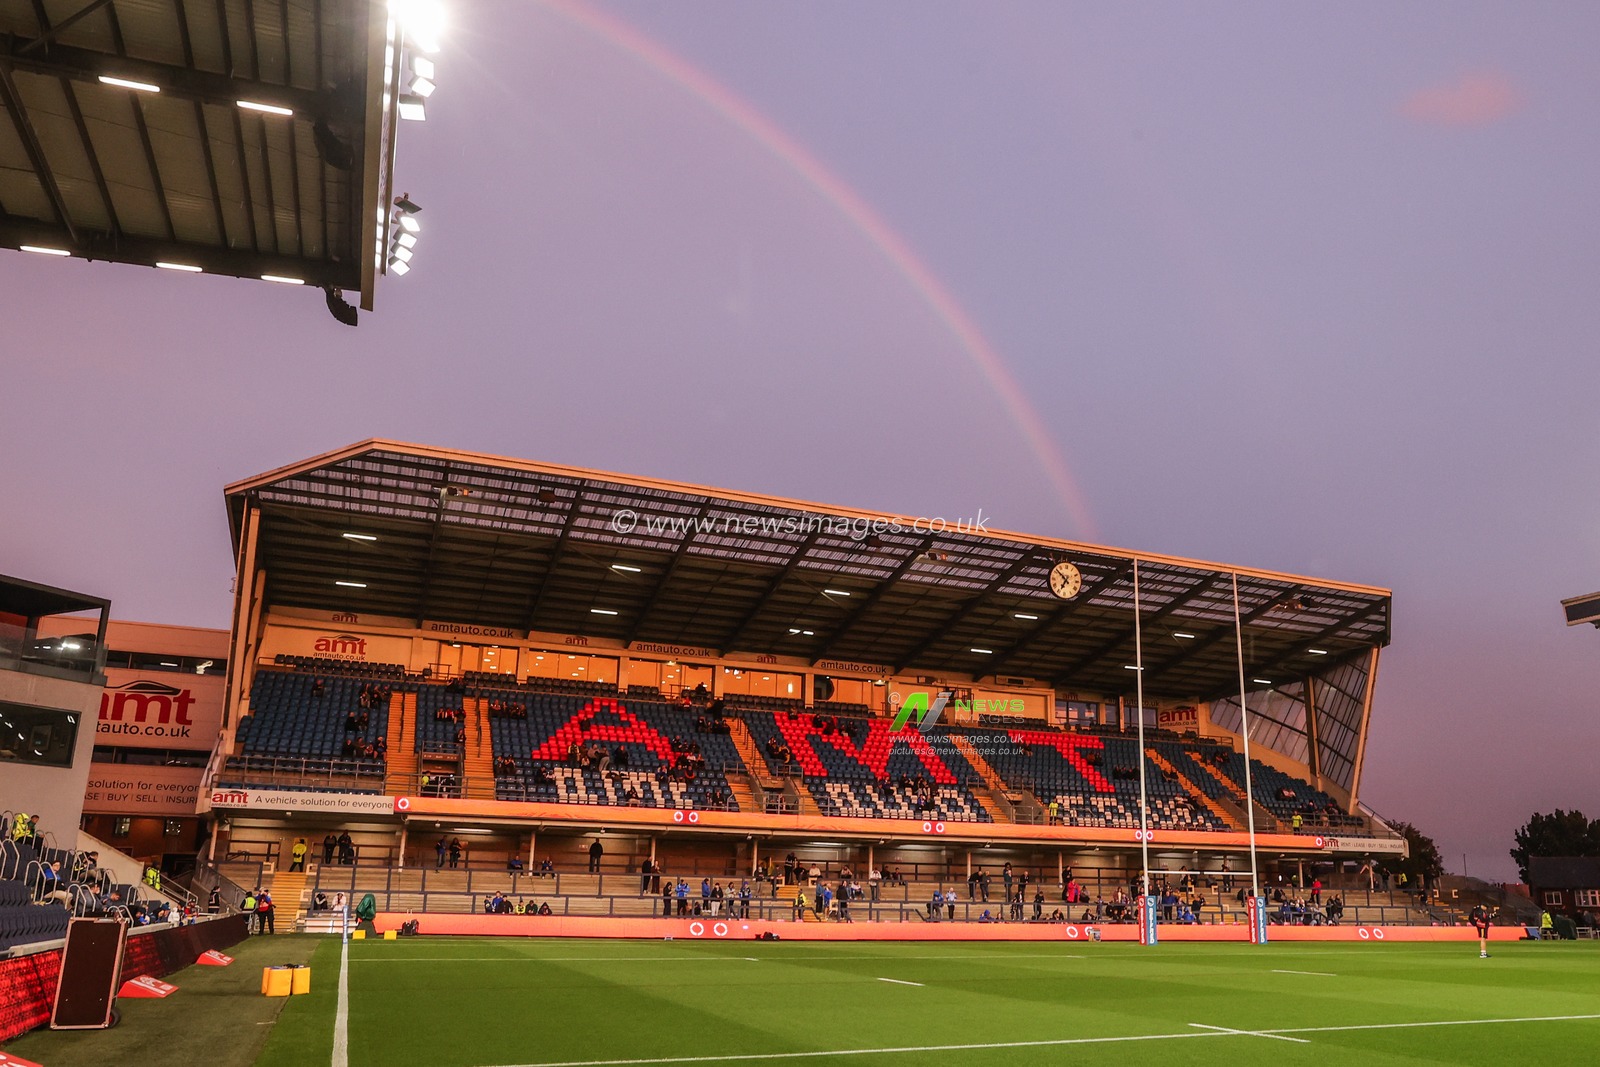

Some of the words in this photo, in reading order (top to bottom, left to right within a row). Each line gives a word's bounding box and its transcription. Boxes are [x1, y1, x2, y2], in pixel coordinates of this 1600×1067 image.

[332, 612, 359, 624] amt
[431, 622, 514, 639] amtauto.co.uk
[314, 638, 368, 655] amt
[636, 642, 711, 657] amtauto.co.uk
[313, 652, 366, 661] amtauto.co.uk
[820, 660, 887, 674] amtauto.co.uk
[98, 689, 196, 726] mt
[1159, 707, 1197, 722] amt
[88, 780, 133, 790] solution
[137, 780, 153, 790] for
[84, 792, 100, 801] SE
[107, 793, 129, 802] BUY
[136, 794, 158, 803] SELL
[212, 792, 249, 804] amt
[255, 795, 263, 804] A
[265, 796, 298, 805] vehicle
[300, 796, 336, 807] solution
[337, 798, 351, 808] for
[352, 800, 393, 811] everyone
